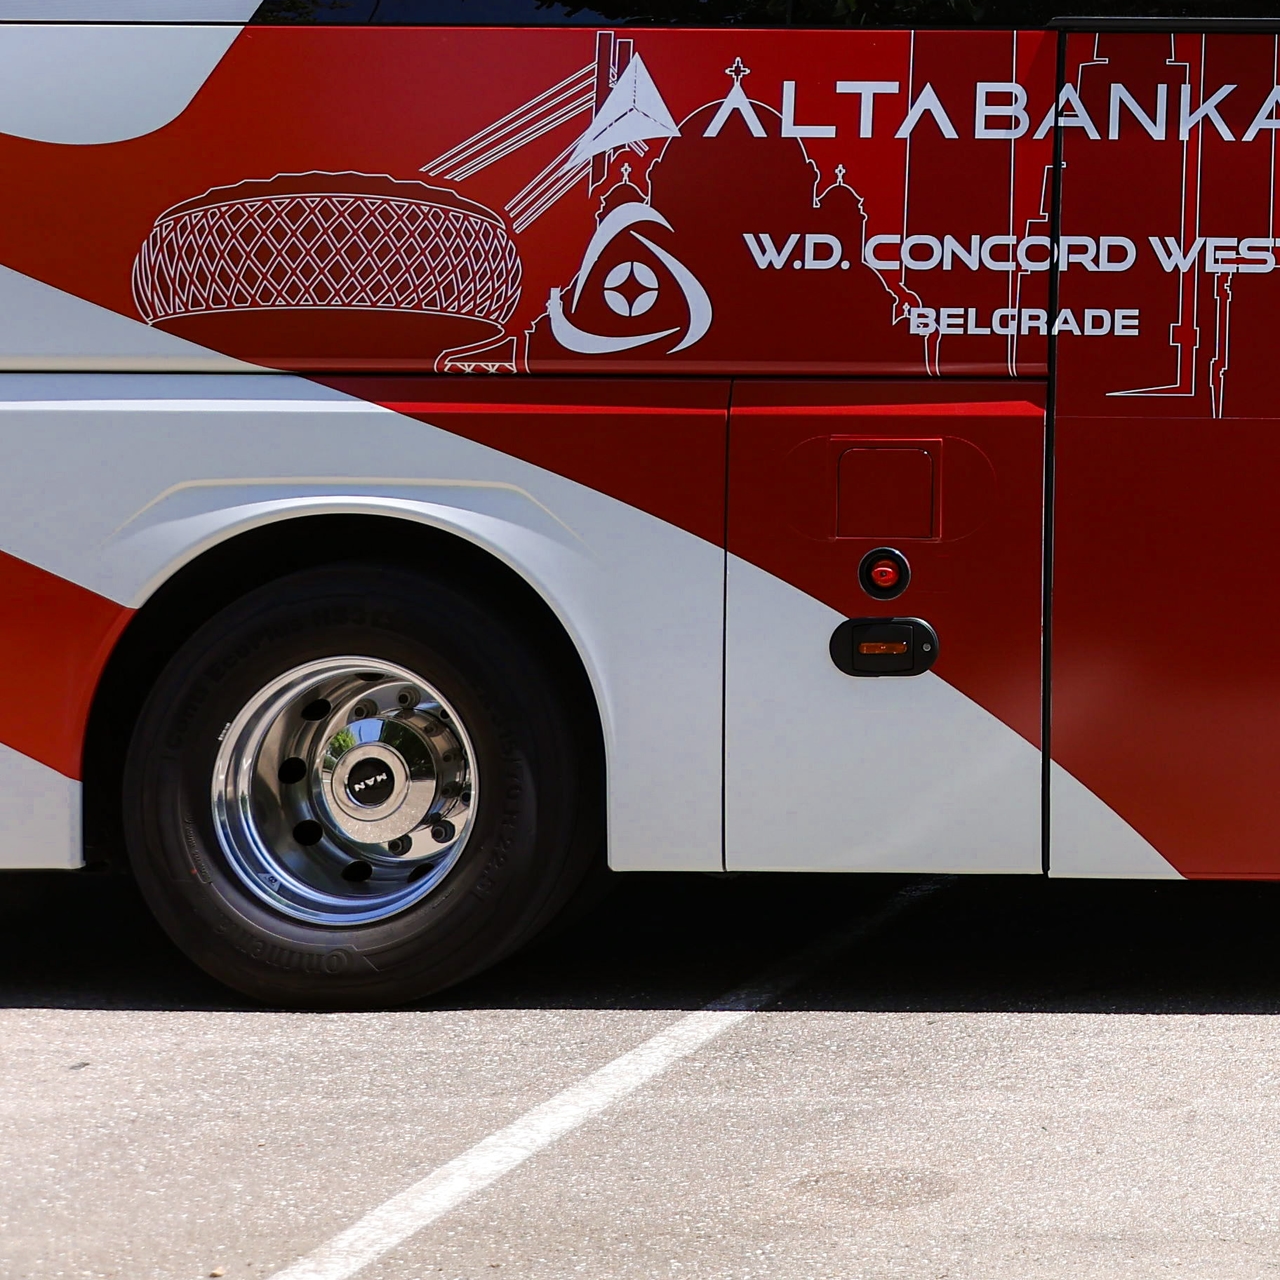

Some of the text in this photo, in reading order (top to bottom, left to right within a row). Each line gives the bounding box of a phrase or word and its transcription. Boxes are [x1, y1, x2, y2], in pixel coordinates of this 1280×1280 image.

[743, 234, 851, 271] W.D.
[864, 235, 1138, 273] CONCORD
[909, 308, 1140, 337] BELGRADE
[353, 772, 388, 792] MAN
